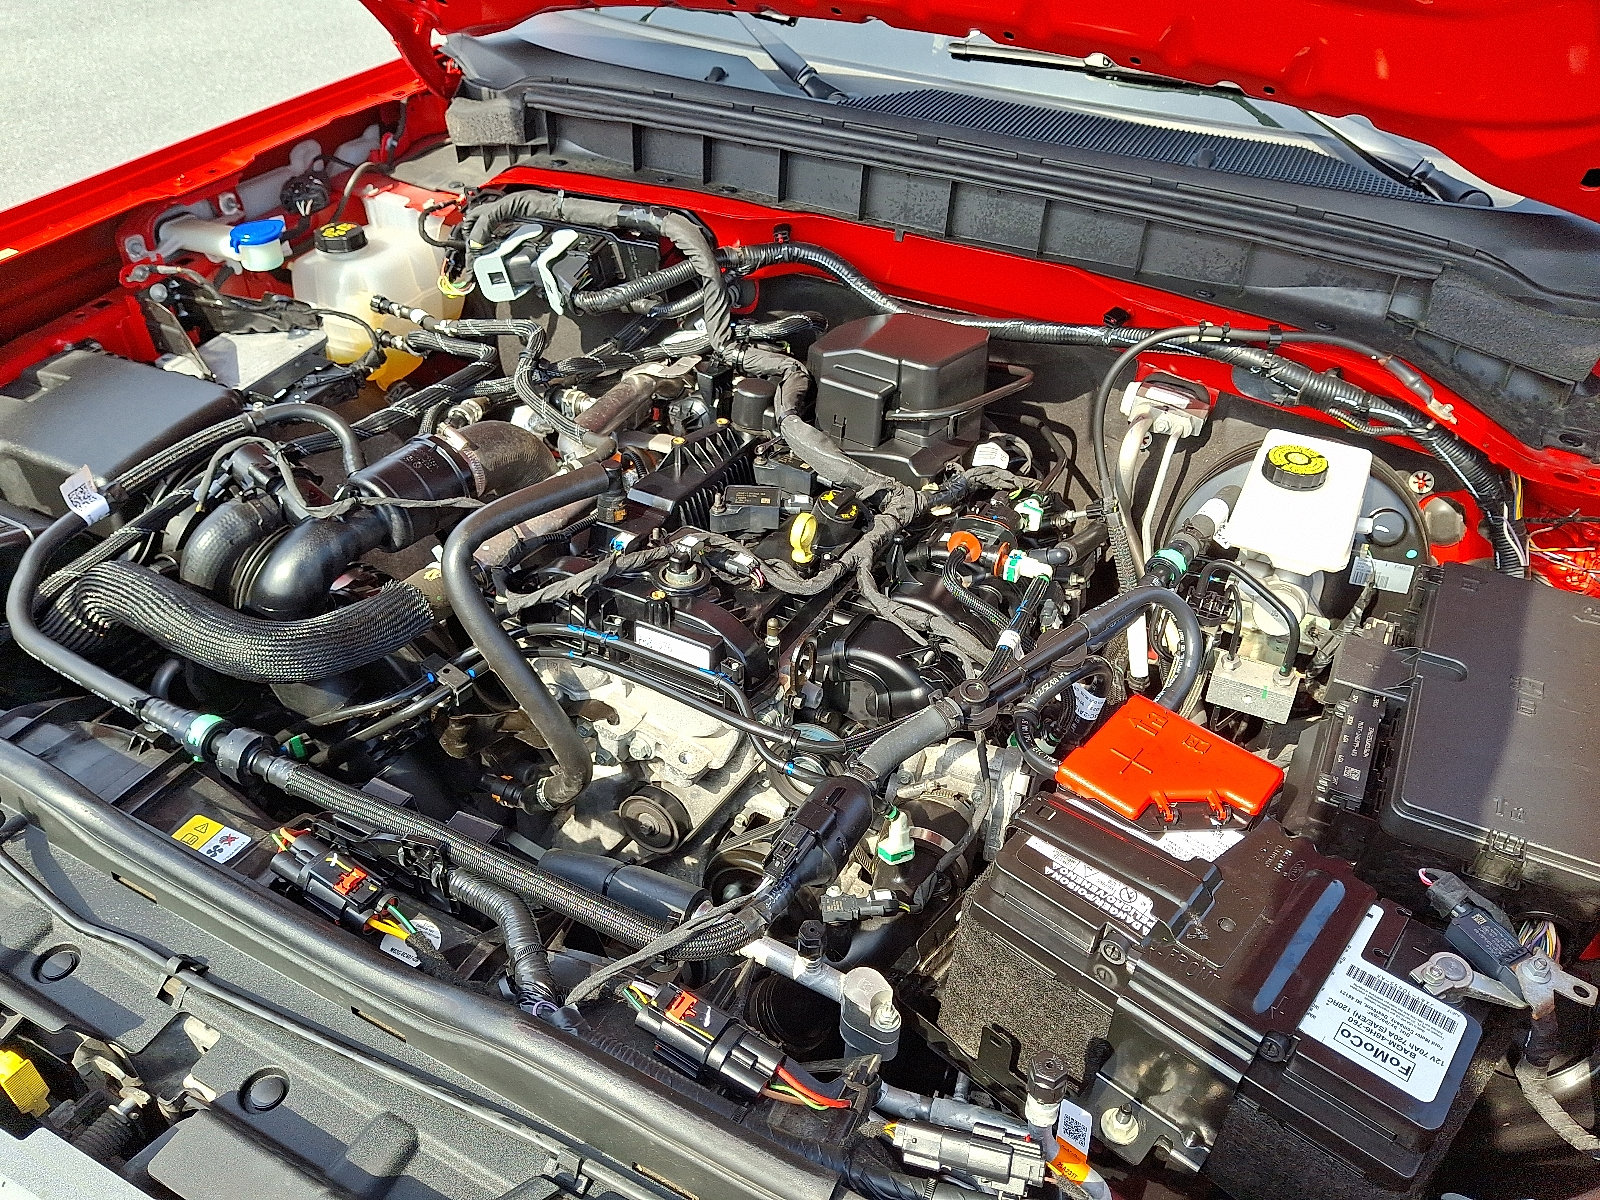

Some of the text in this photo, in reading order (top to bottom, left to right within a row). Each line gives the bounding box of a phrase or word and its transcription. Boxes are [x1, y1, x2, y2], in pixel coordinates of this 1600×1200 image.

[1050, 870, 1143, 930] DANGER/POISON
[1351, 1009, 1387, 1034] (SAE/EN)
[1386, 1030, 1408, 1045] 720A
[1337, 1026, 1412, 1076] FoMoCo
[1407, 1041, 1429, 1057] 70Ah
[1429, 1054, 1446, 1066] 12V
